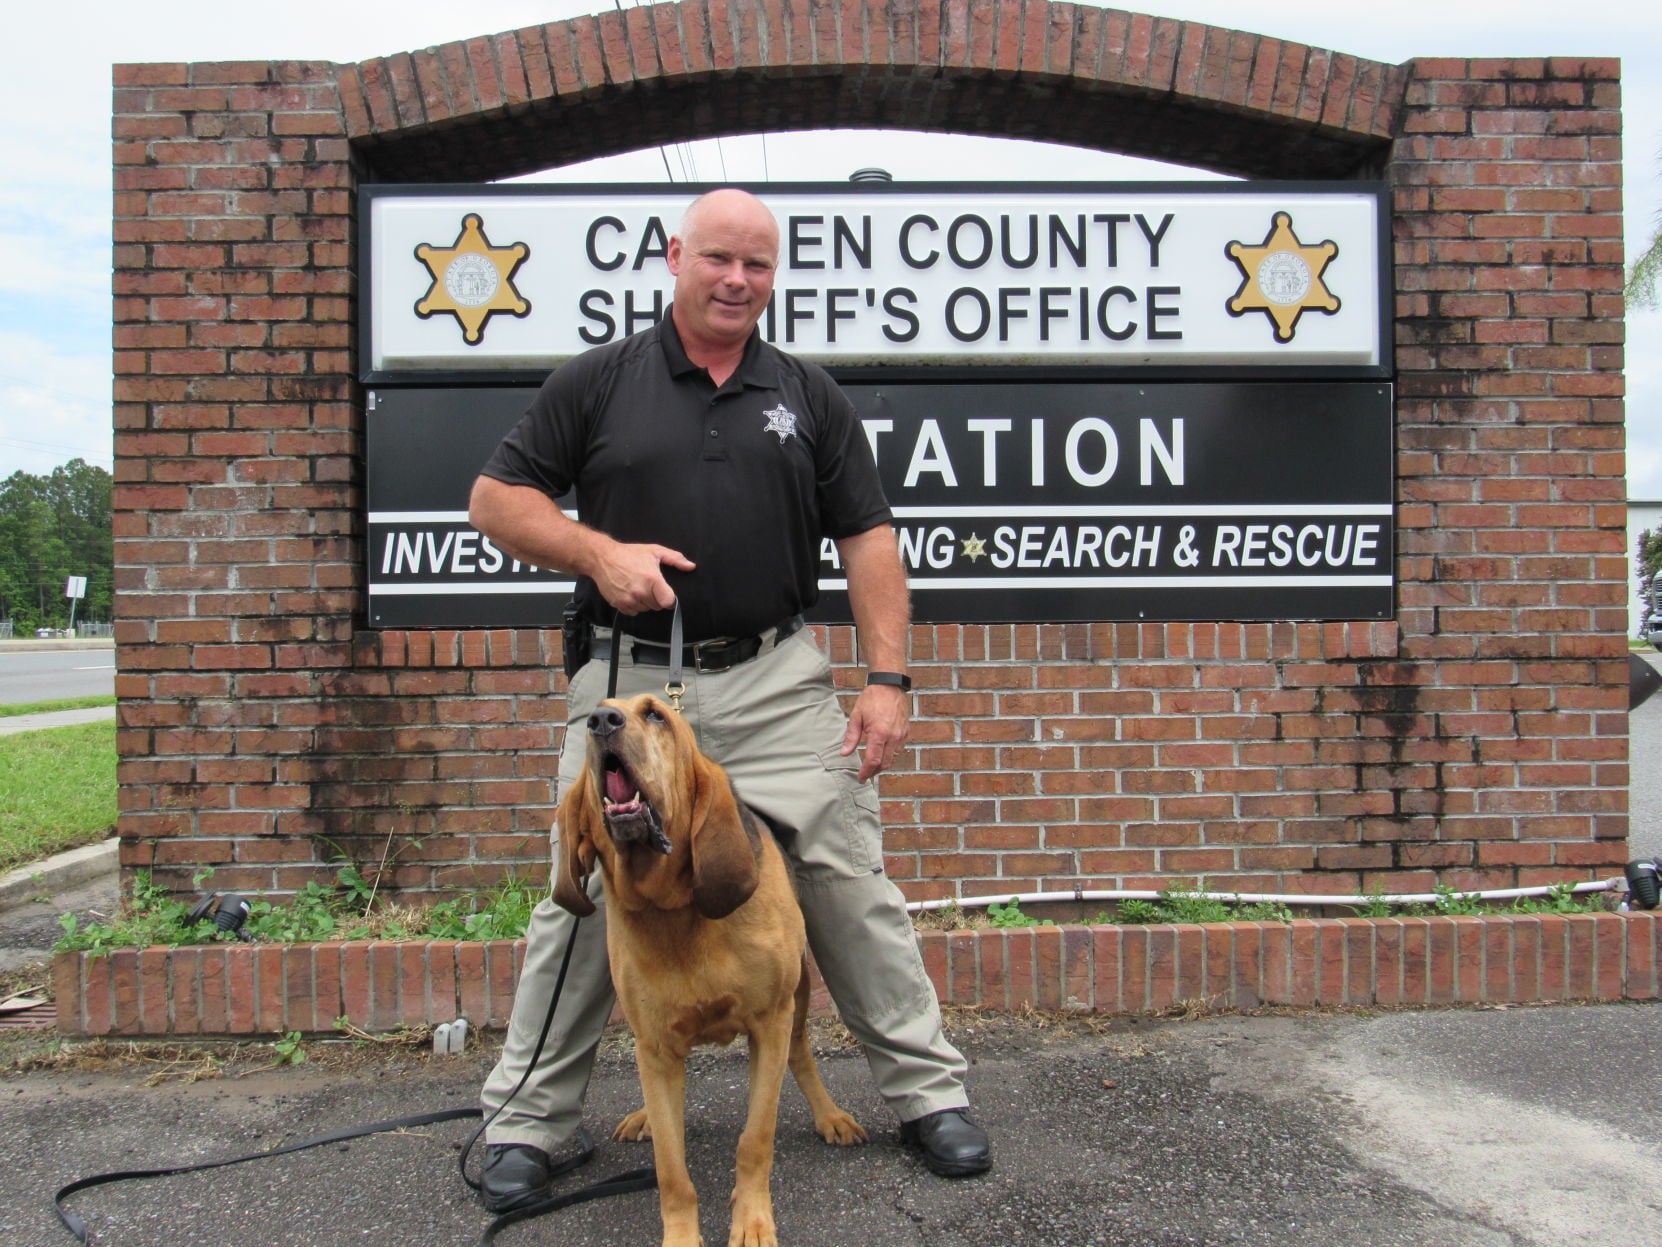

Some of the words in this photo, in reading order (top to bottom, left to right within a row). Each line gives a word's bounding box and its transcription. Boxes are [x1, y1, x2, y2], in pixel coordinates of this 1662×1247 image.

[584, 215, 872, 271] CAEN
[898, 213, 1175, 270] COUNTY
[578, 287, 920, 345] SHIFF'S
[944, 285, 1183, 343] OFFICE
[861, 417, 1185, 487] TATION
[990, 525, 1162, 570] SEARCH
[1173, 524, 1201, 568] &
[1212, 524, 1380, 568] RESCUE
